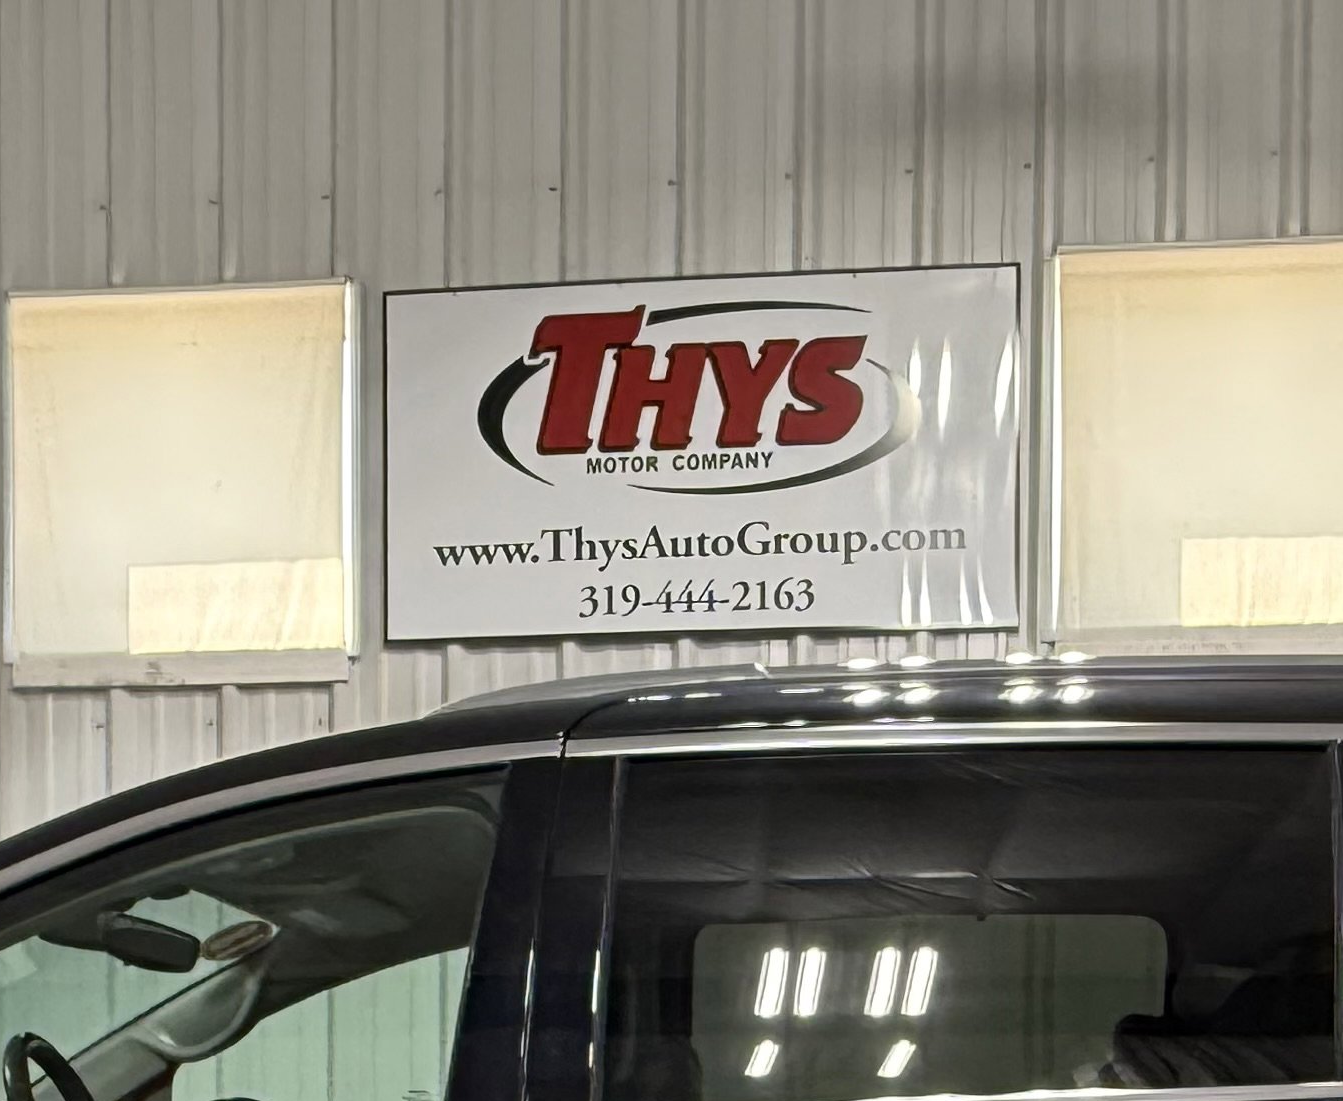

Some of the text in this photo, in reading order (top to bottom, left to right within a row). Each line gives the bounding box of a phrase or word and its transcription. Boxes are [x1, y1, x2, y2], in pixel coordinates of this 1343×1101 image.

[529, 304, 868, 455] THYS
[586, 450, 774, 474] MOTOR COMPANY
[433, 522, 967, 572] www.ThysAutoGroup.com
[579, 577, 815, 618] 319-444-2163
